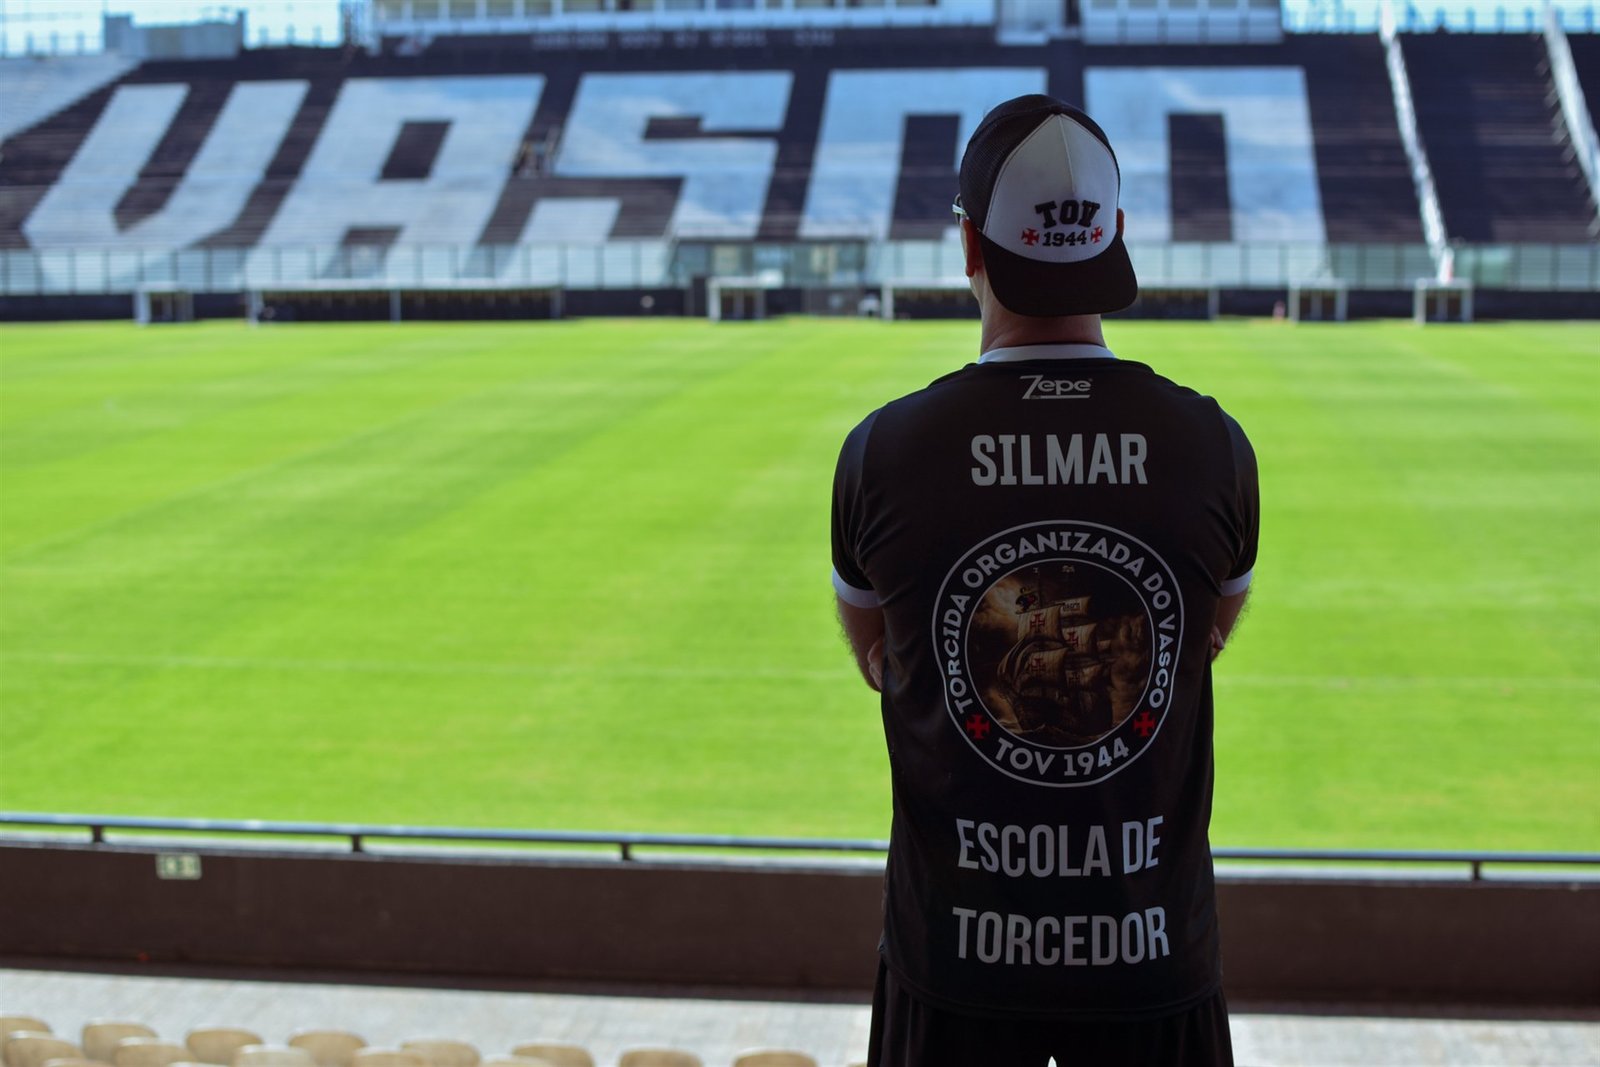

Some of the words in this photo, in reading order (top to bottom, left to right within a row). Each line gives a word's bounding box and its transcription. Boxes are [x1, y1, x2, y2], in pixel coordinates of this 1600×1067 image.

[22, 68, 1327, 288] VASCO
[1034, 199, 1101, 229] TOV
[1042, 230, 1088, 247] 1944
[970, 433, 1149, 487] SILMAR
[962, 531, 1146, 589] ORGANIZADA
[1142, 572, 1172, 610] DO
[943, 592, 973, 714] TORCIDA
[1149, 613, 1176, 709] VASCO
[993, 737, 1055, 776] TOV
[1063, 736, 1130, 777] 1944
[956, 818, 1112, 878] ESCOLA
[1122, 815, 1164, 875] DE
[952, 906, 1171, 966] TORCEDOR
